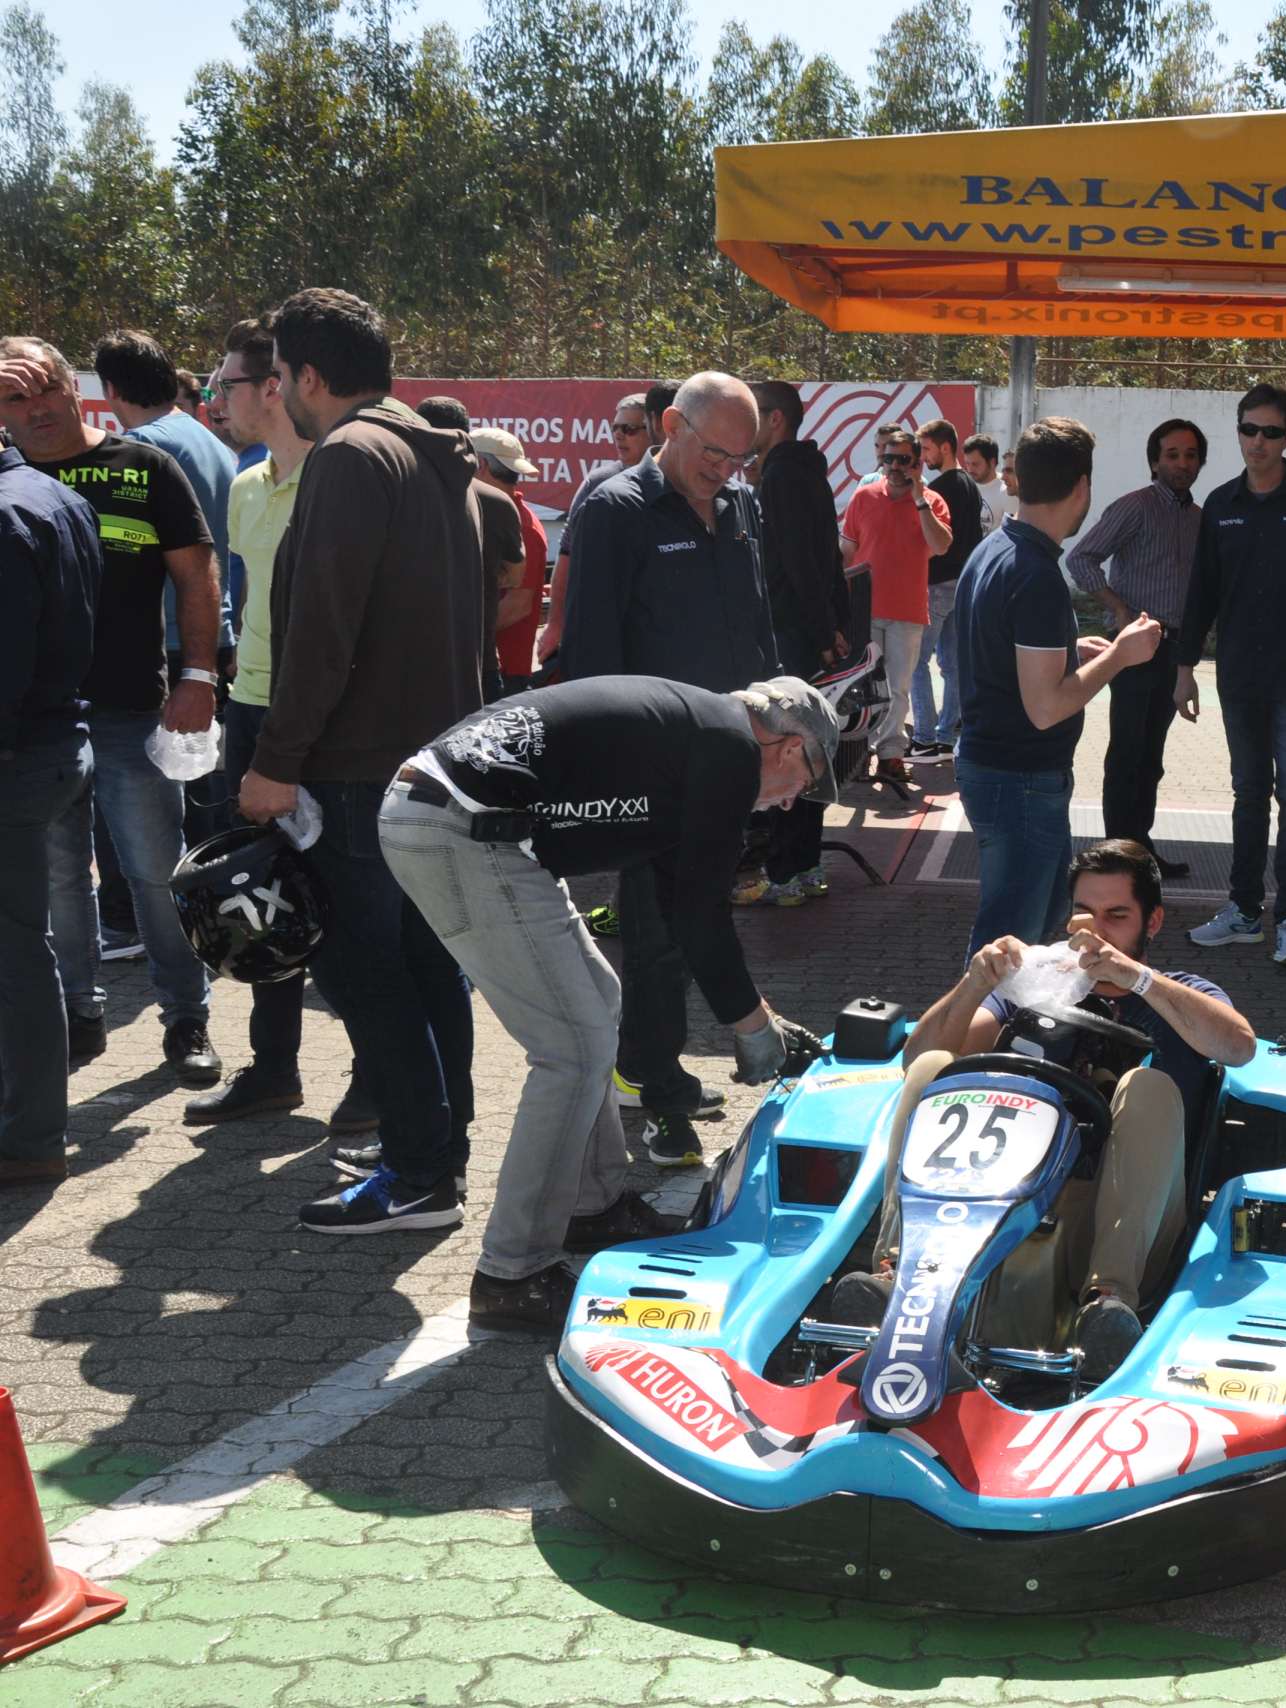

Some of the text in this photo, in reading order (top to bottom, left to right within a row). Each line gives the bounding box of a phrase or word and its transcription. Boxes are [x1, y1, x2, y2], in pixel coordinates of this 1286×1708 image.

[468, 417, 616, 443] ENTROS MA
[58, 466, 149, 486] MTN-R1
[932, 1093, 1038, 1110] EUROINDY
[924, 1102, 1018, 1170] 25
[638, 1304, 712, 1331] eni
[631, 1359, 735, 1442] HURON
